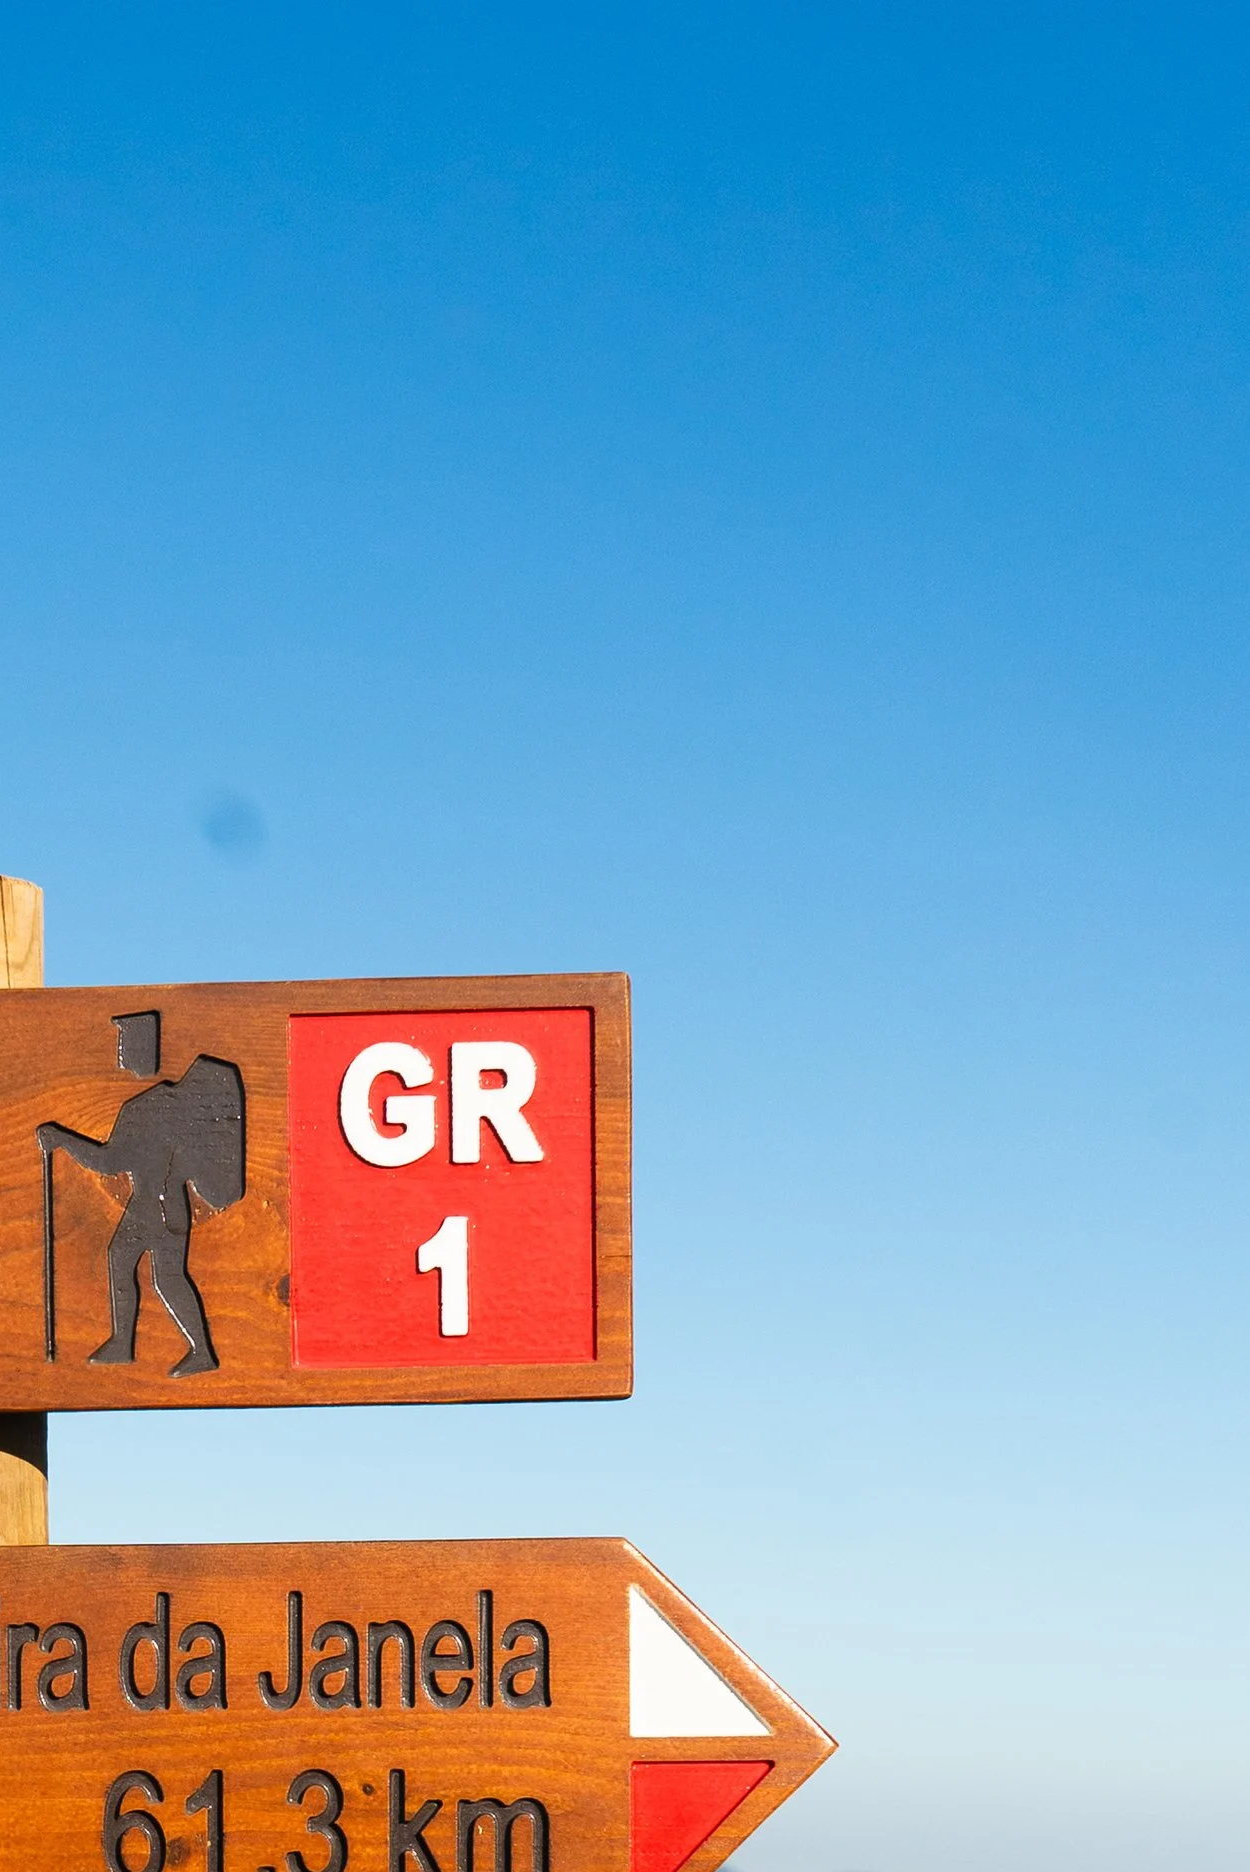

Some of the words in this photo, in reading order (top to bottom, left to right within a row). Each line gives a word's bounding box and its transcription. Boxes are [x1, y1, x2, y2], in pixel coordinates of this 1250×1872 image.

[339, 1040, 545, 1168] GR
[416, 1215, 470, 1338] 1
[119, 1590, 229, 1712] da
[257, 1588, 552, 1710] Janela
